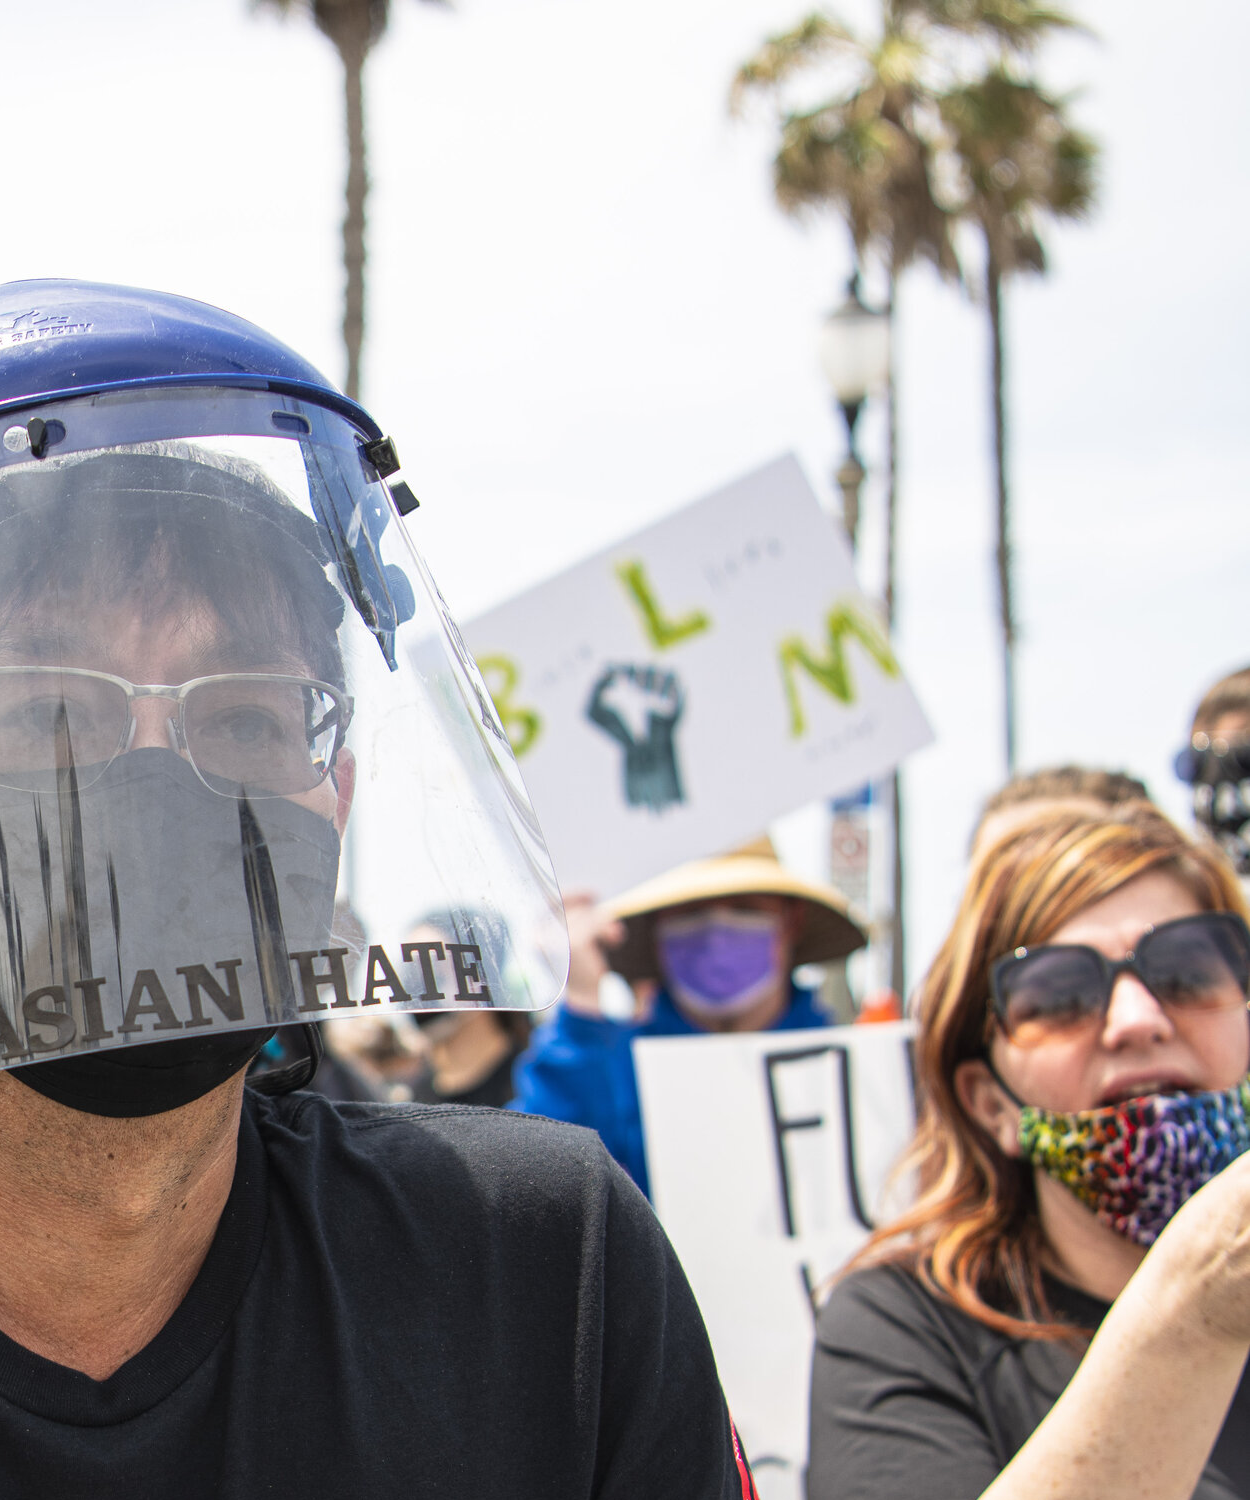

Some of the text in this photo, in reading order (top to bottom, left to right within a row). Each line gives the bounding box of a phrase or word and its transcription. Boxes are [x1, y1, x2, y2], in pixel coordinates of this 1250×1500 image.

[614, 559, 710, 651] L
[777, 600, 901, 741] M
[288, 942, 492, 1013] HATE
